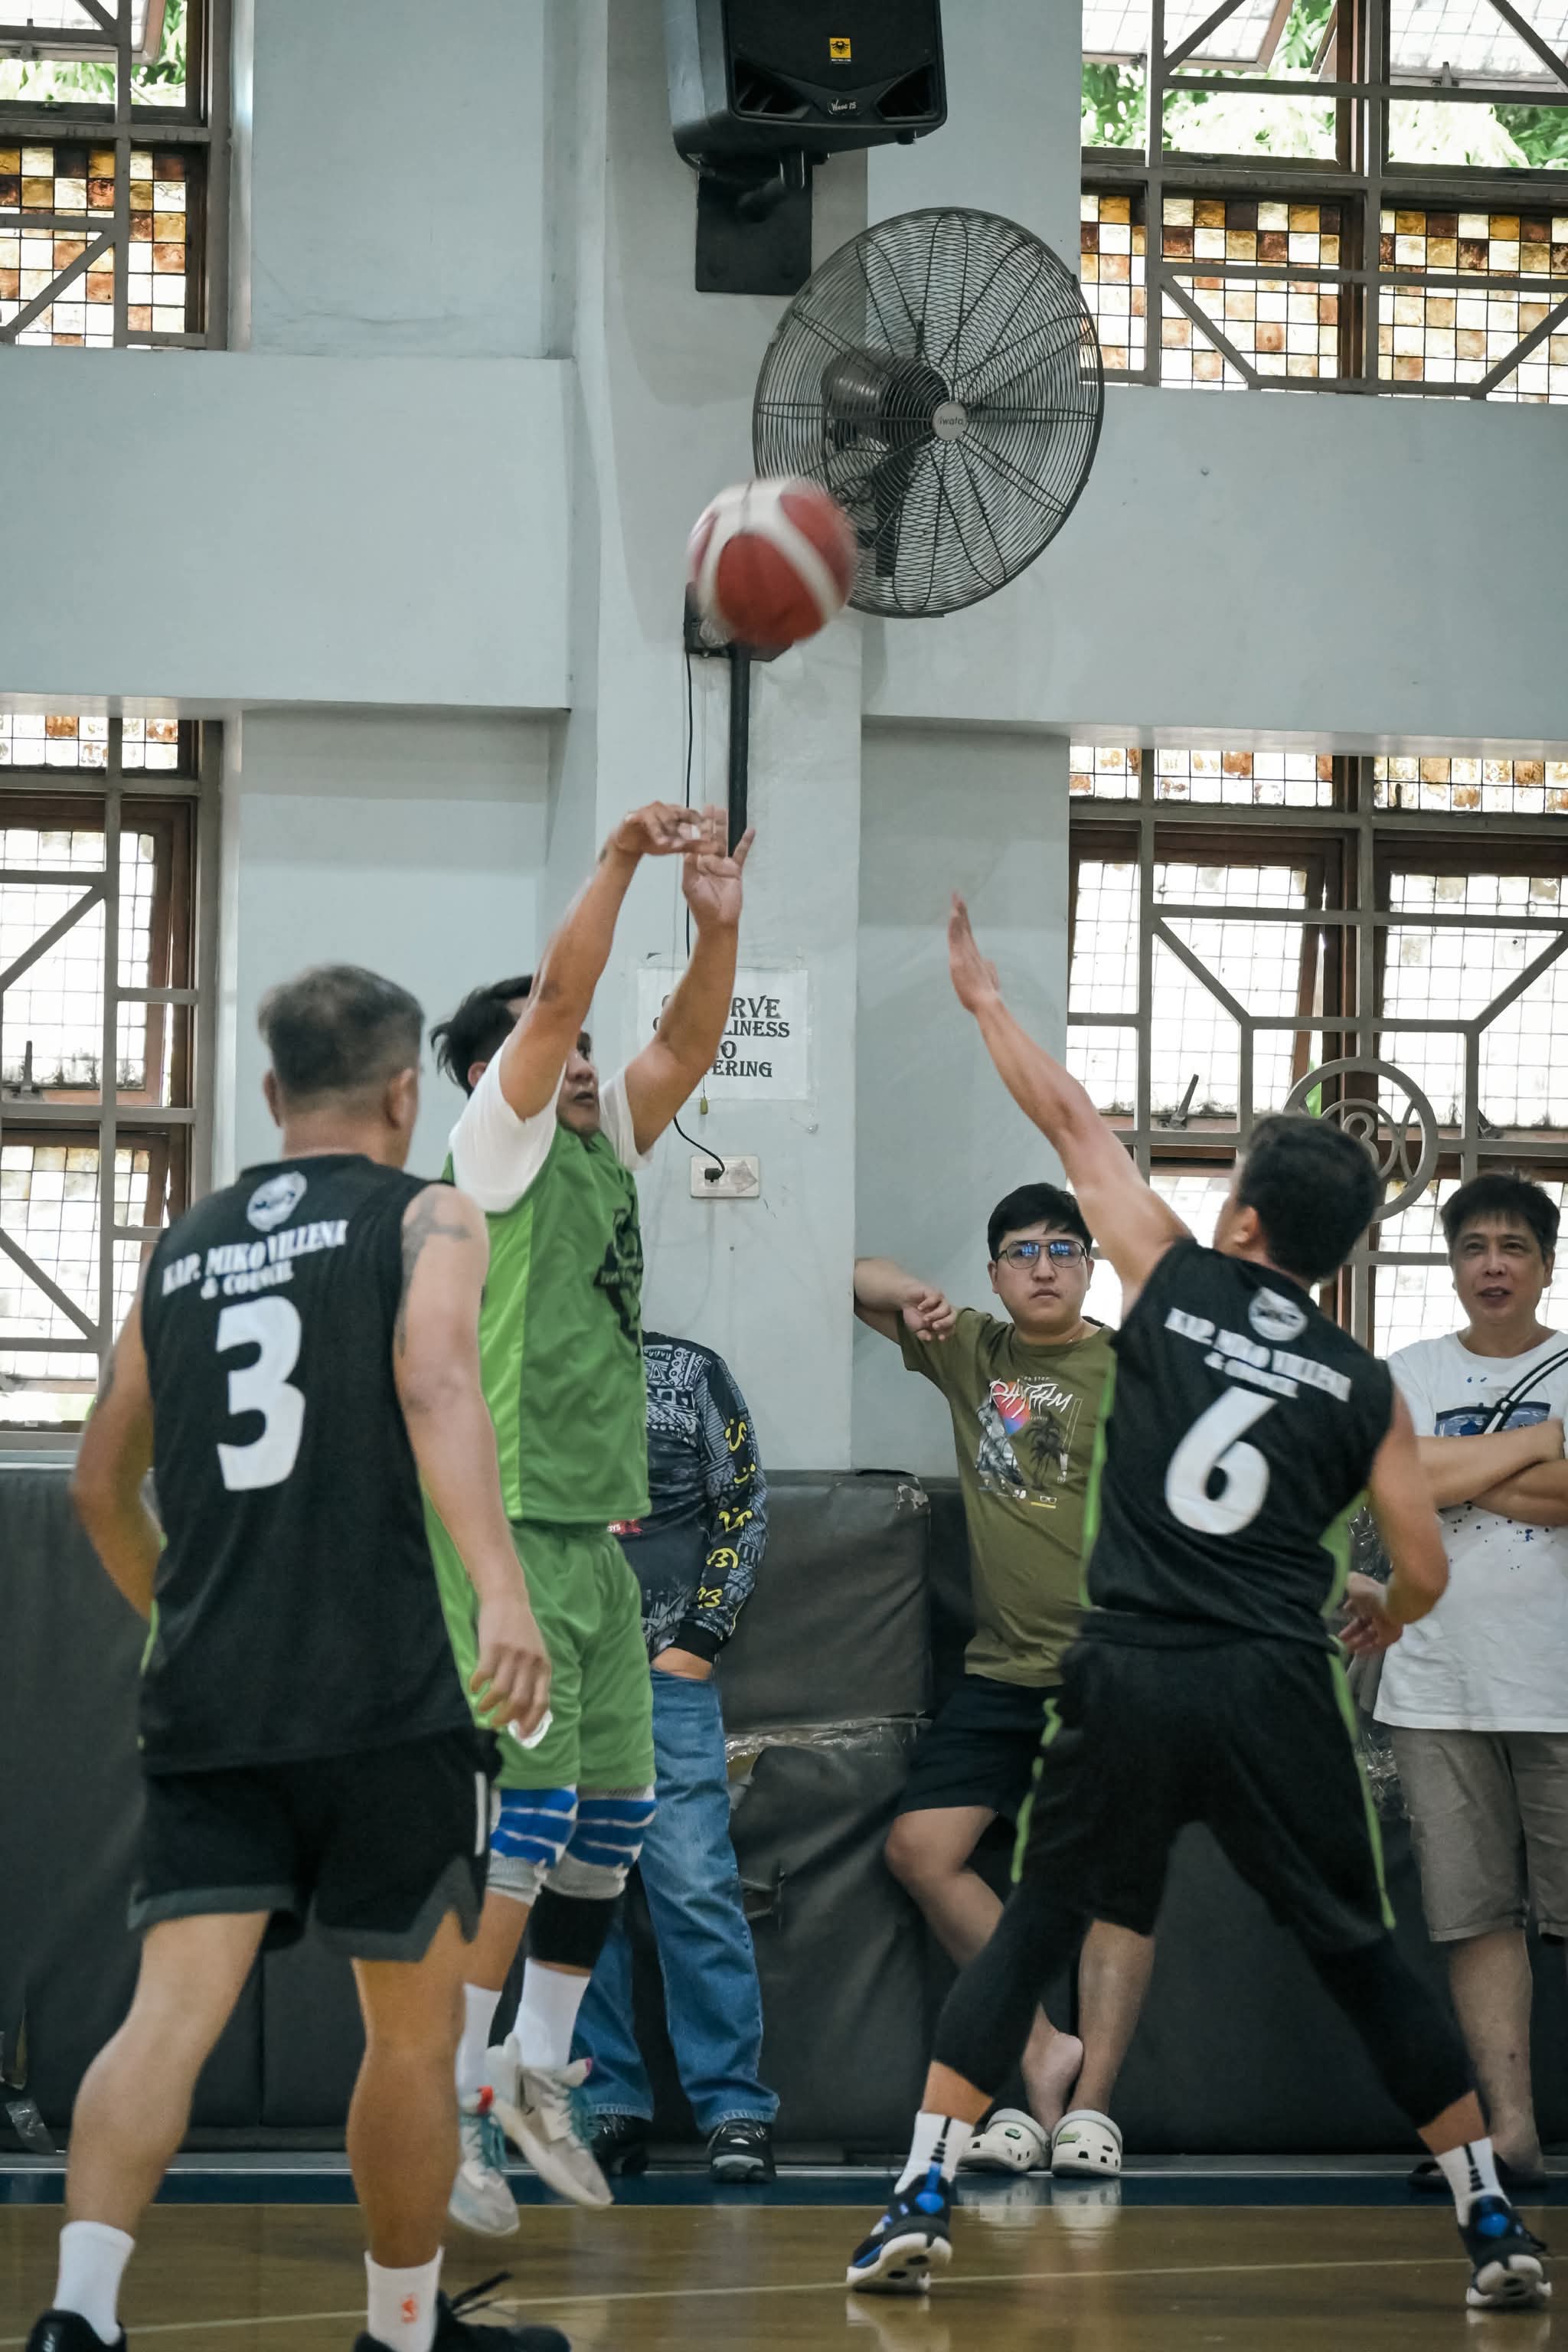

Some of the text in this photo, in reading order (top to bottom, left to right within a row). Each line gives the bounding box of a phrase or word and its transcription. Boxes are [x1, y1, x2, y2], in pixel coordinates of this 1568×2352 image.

[710, 1060, 773, 1077] ERING
[216, 1296, 306, 1491] 3
[1165, 1386, 1278, 1535] 6
